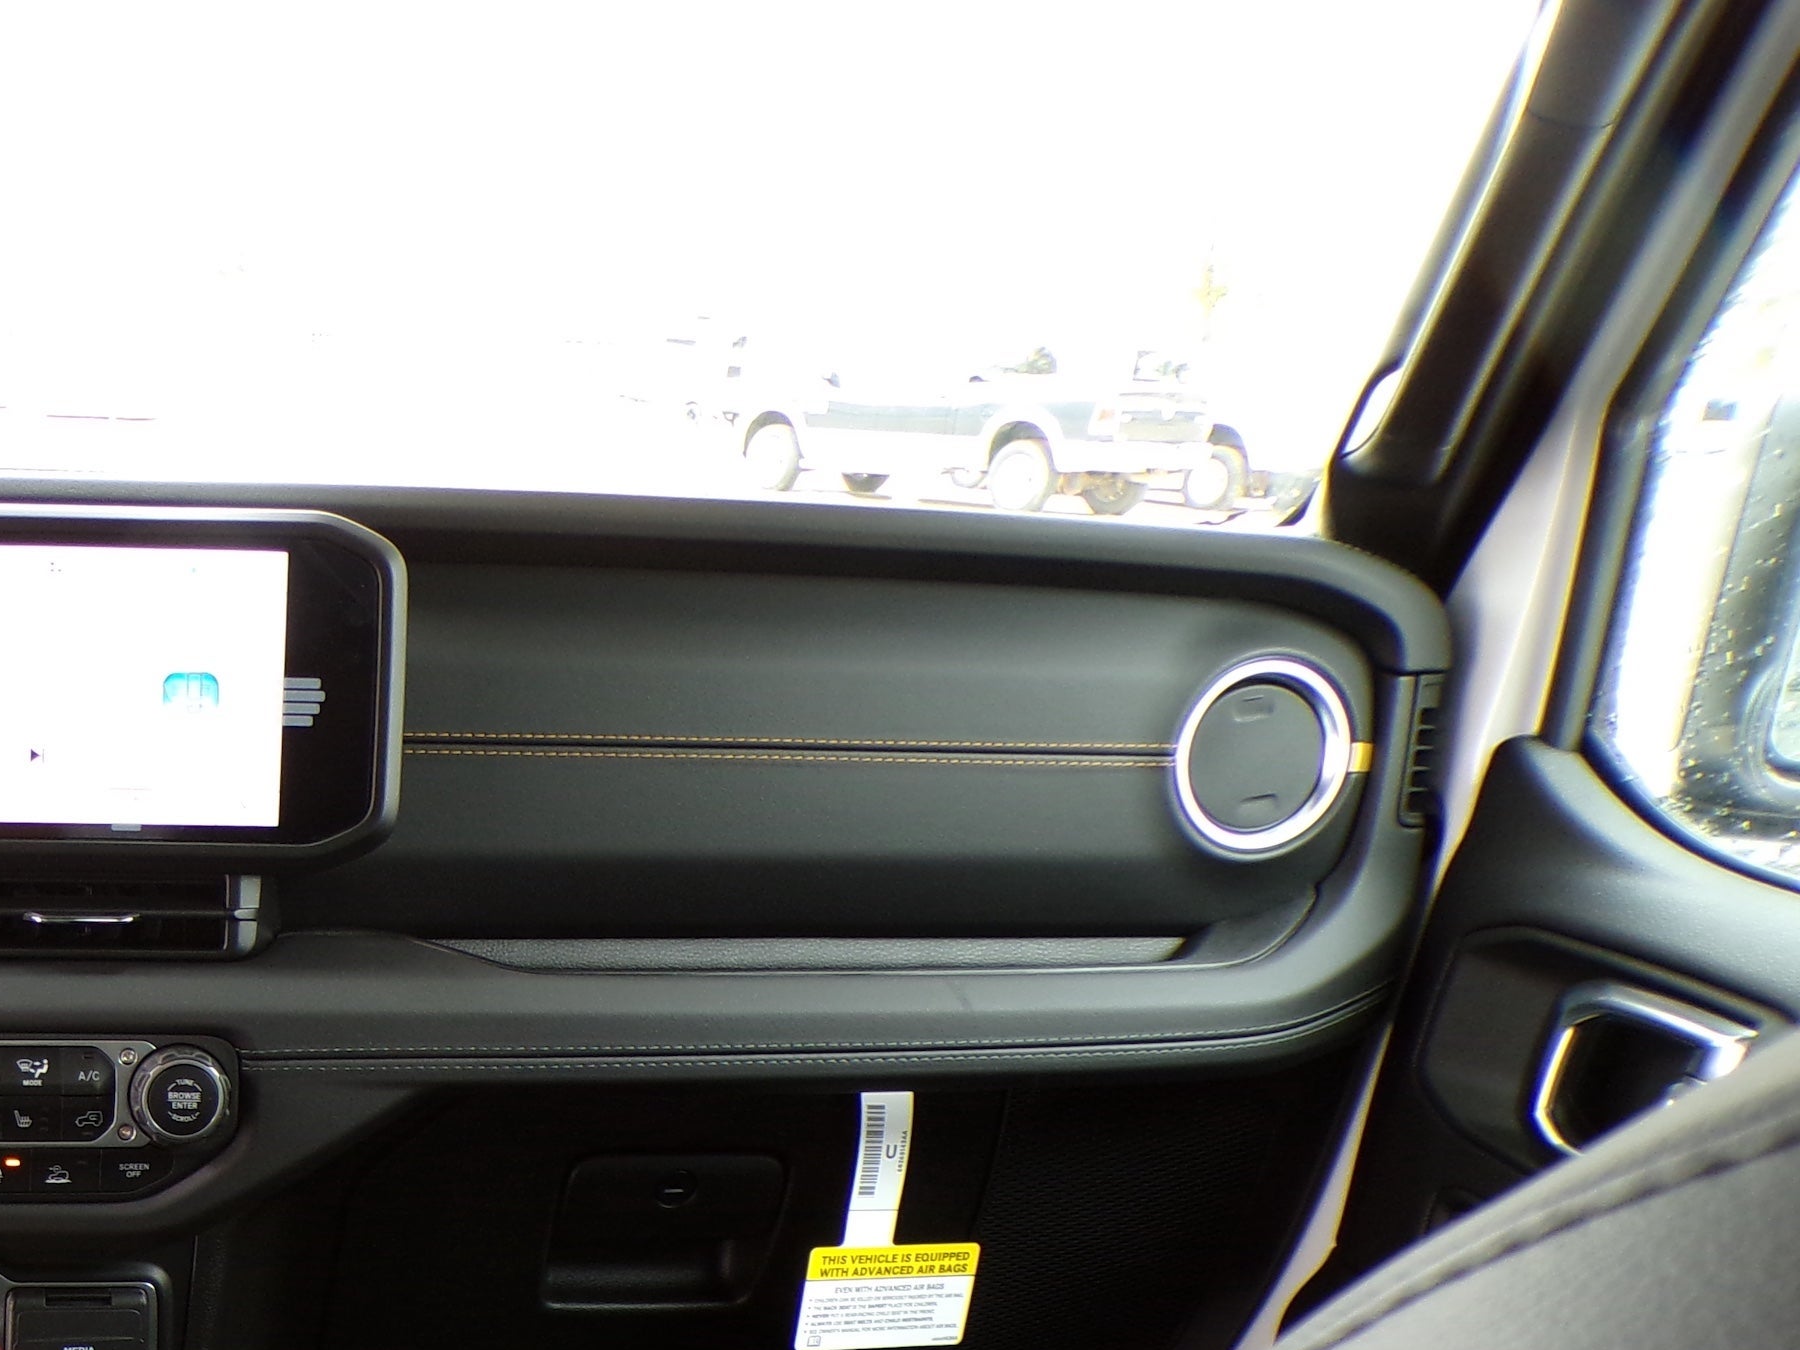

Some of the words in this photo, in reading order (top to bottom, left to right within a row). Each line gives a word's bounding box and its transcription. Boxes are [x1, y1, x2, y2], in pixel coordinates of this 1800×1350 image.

[78, 1070, 100, 1082] A/C
[22, 1079, 43, 1087] MODE
[175, 1078, 195, 1087] TUNE
[168, 1091, 201, 1100] BROWSE
[171, 1101, 198, 1110] ENTER
[171, 1113, 197, 1122] SCROLL
[119, 1163, 150, 1171] SCREEN
[126, 1170, 141, 1178] OFF
[822, 1255, 847, 1266] THIS
[851, 1253, 899, 1264] VEHICLE
[900, 1253, 912, 1263] IS
[914, 1251, 970, 1263] EQUIPPED
[820, 1267, 849, 1278] WITH
[851, 1265, 914, 1277] ADVANCED
[916, 1264, 936, 1274] AIR
[938, 1263, 968, 1274] BAGS
